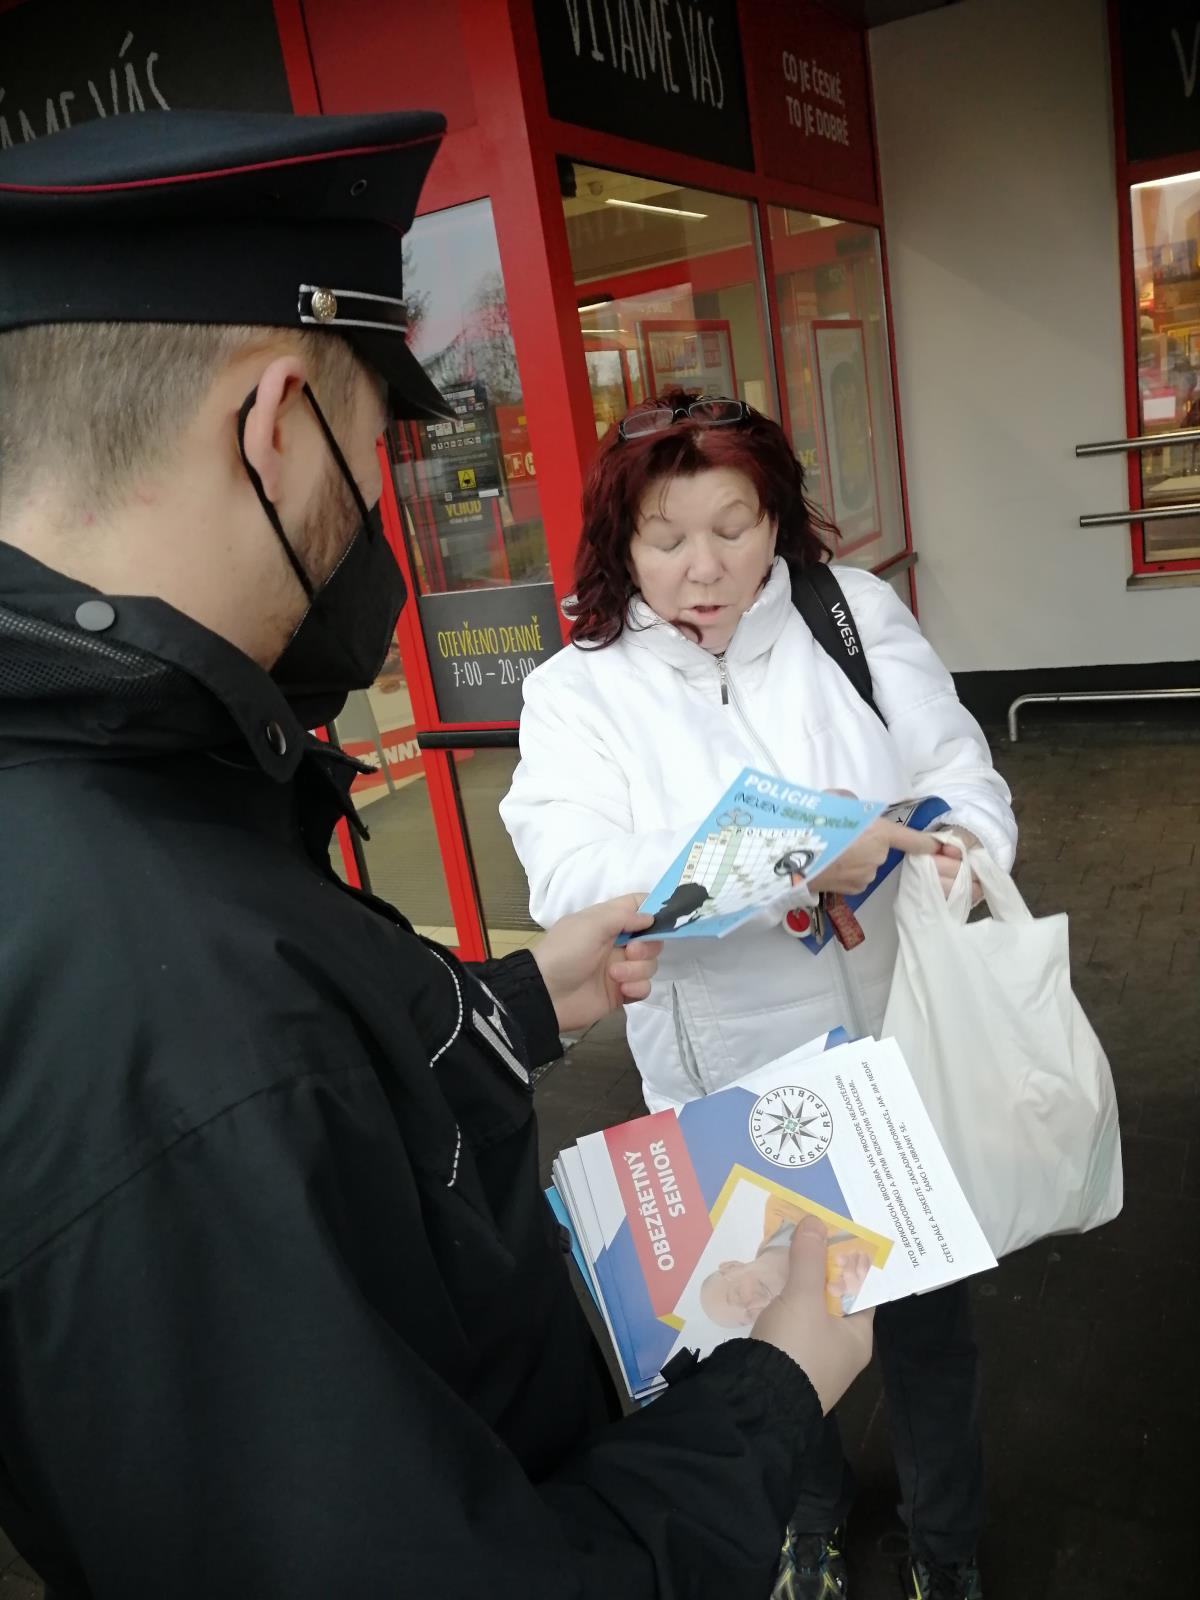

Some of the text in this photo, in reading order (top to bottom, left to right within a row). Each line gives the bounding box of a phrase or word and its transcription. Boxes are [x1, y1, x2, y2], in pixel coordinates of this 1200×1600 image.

[782, 51, 798, 84] CO
[799, 58, 812, 93] JE
[785, 95, 849, 146] TO JE DOBRÉ
[438, 615, 544, 658] OTEVŘENO DENNĚ
[452, 661, 483, 688] 7:00
[743, 774, 821, 810] POLICIE
[861, 1061, 875, 1082] NEDAT
[870, 1083, 880, 1094] JIM
[877, 1095, 886, 1108] JAK
[753, 1088, 831, 1164] POLICIE ČESKÉ REPUBLIKY
[853, 1122, 871, 1153] PROVEDE
[650, 1139, 686, 1218] SENIOR
[623, 1151, 675, 1271] OBEZŘETNÝ
[907, 1250, 920, 1269] TATO
[913, 1237, 927, 1257] TRIKY
